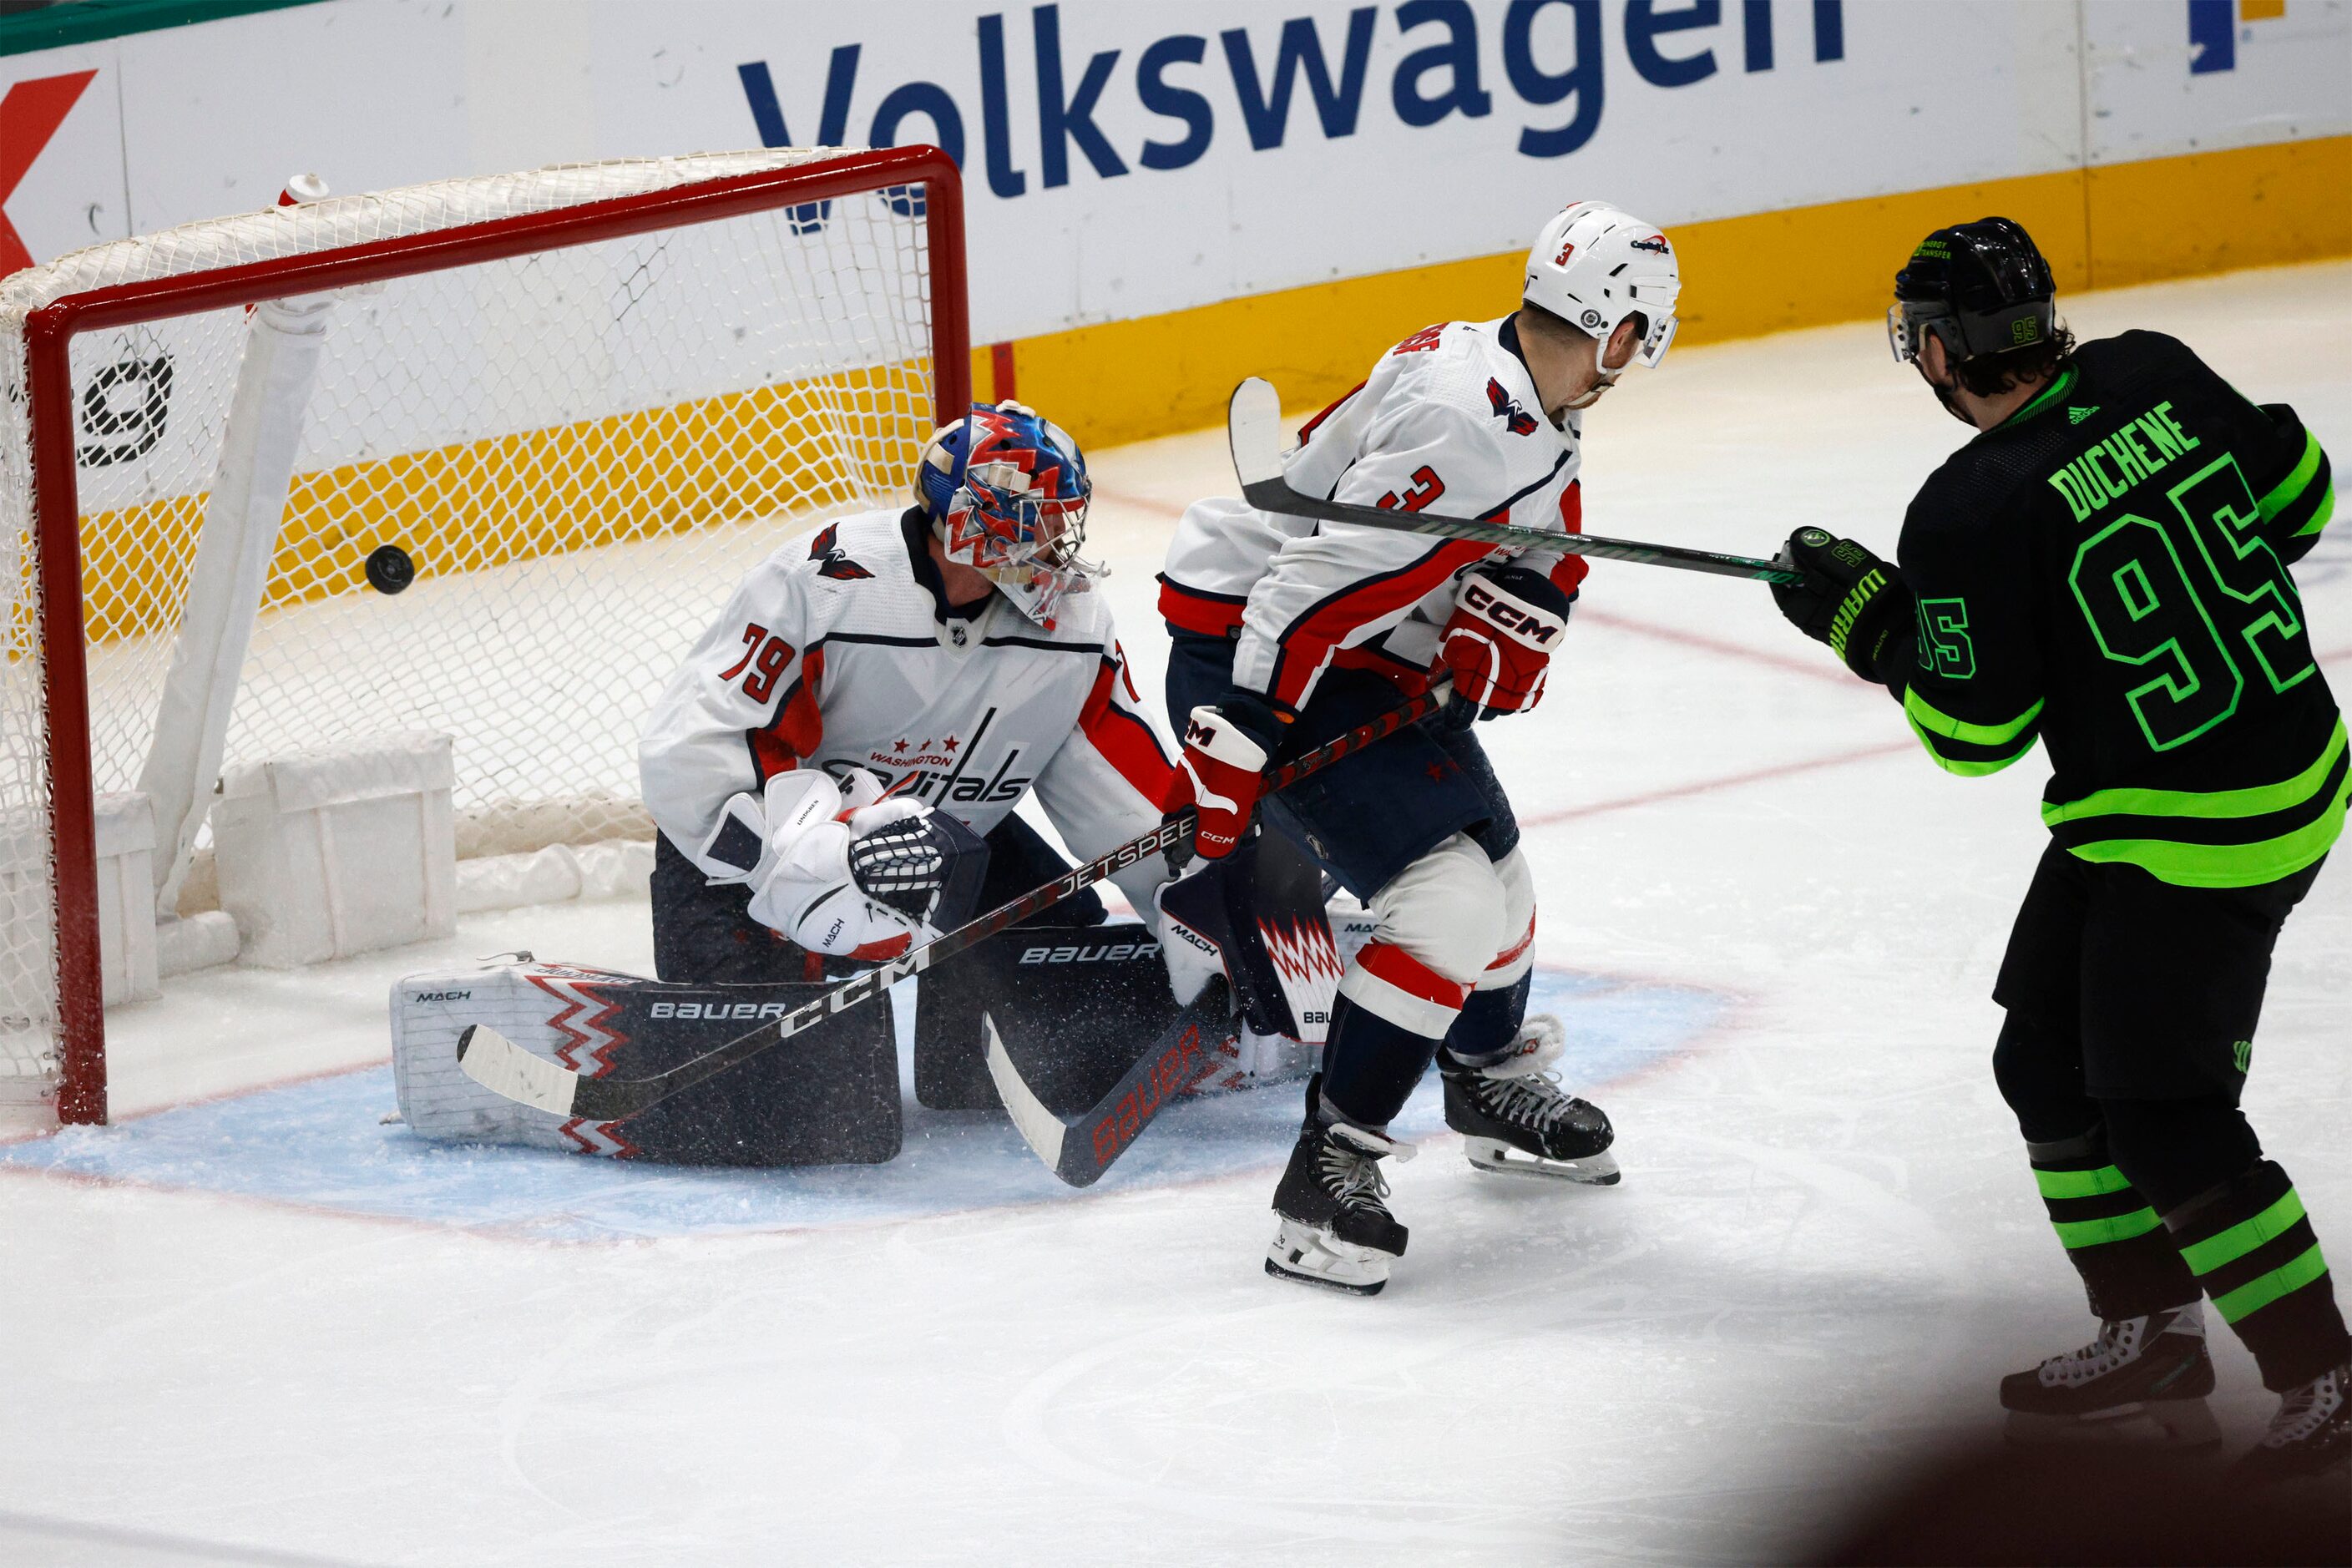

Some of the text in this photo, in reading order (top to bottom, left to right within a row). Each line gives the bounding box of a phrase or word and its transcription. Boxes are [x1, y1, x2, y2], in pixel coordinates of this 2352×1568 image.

[1555, 243, 1575, 266] 3
[2011, 316, 2037, 344] 95
[2047, 400, 2201, 523] DUCHENE
[1464, 584, 1559, 645] CCM
[2068, 451, 2317, 752] 95
[1914, 591, 1976, 680] 5
[718, 622, 797, 705] 79
[870, 751, 954, 768] WASHINGTON
[797, 799, 819, 826] LINDGREN
[1201, 830, 1235, 844] CCM
[822, 918, 845, 948] MACH
[1171, 924, 1218, 957] MACH
[417, 991, 471, 1003] MACH
[781, 944, 930, 1038] CCM
